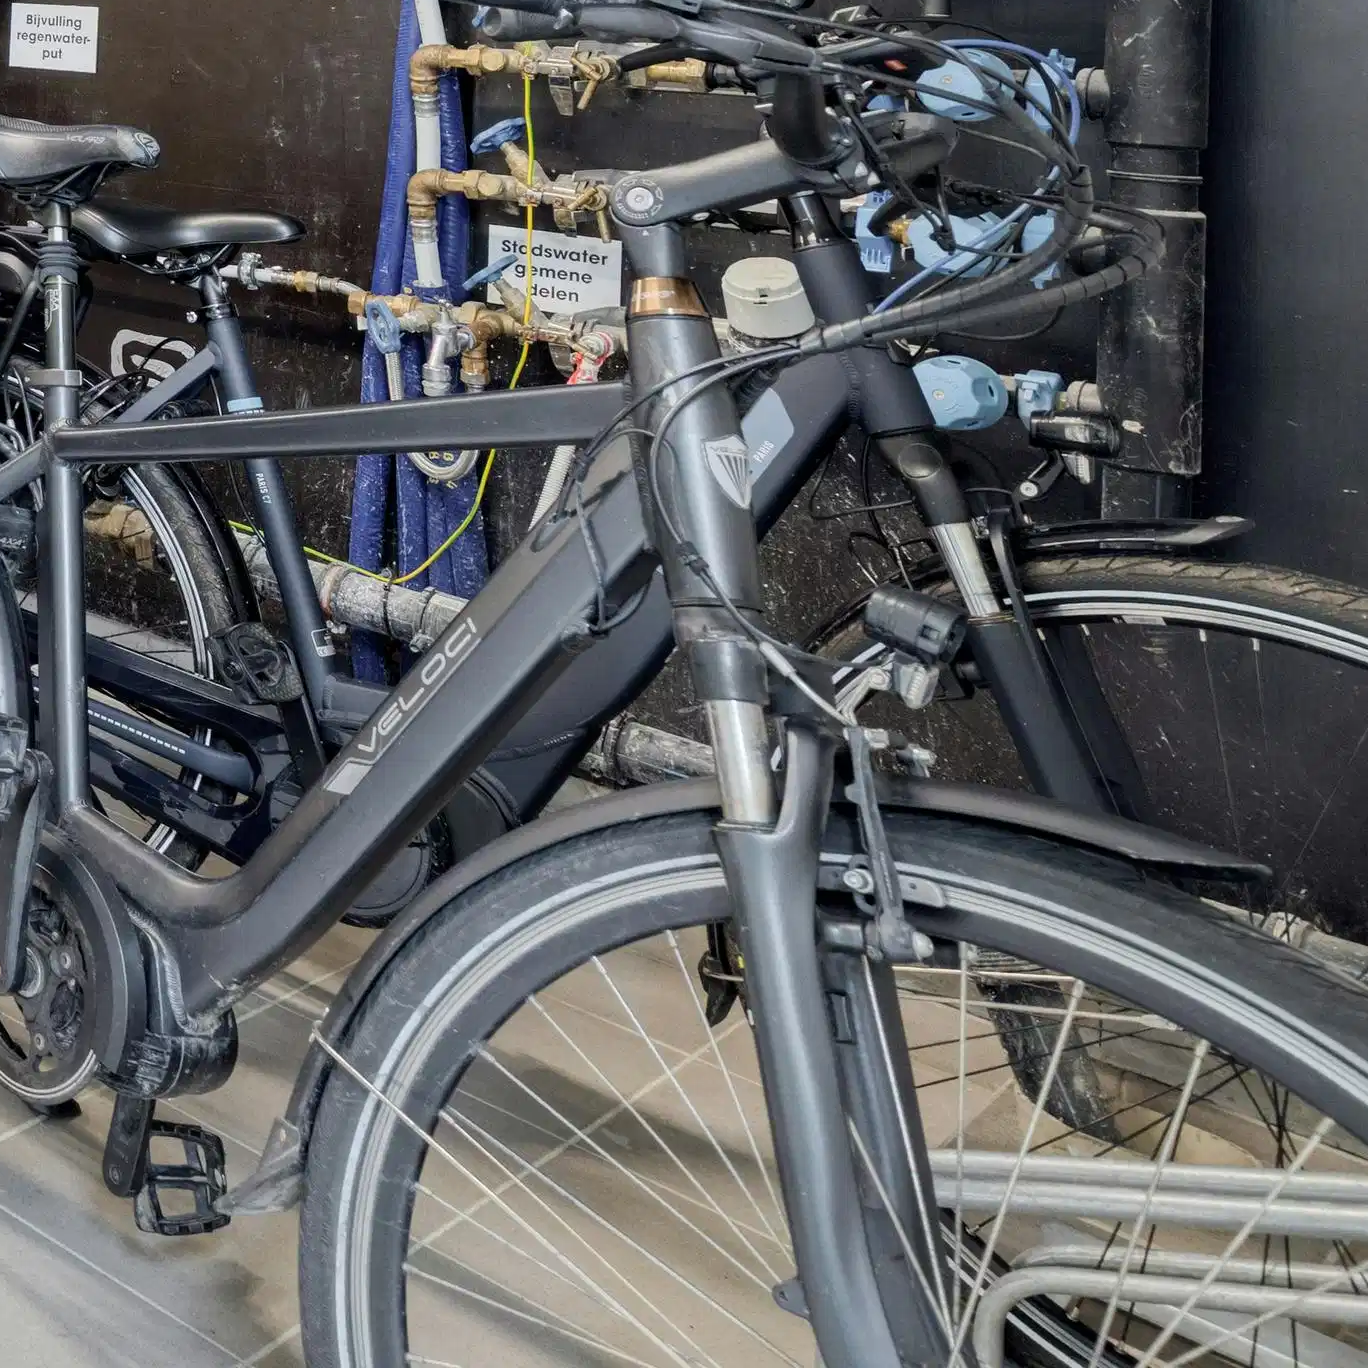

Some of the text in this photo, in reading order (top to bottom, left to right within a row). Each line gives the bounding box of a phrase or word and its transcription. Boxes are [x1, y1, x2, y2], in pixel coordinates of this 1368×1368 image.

[26, 14, 82, 30] Bijvulling
[16, 32, 91, 45] regenwater-
[42, 48, 63, 60] put
[501, 240, 608, 265] Stadswater
[514, 263, 592, 284] gemene
[752, 440, 775, 464] PARIS
[256, 473, 269, 494] PARIS
[357, 617, 477, 753] VELOCI
